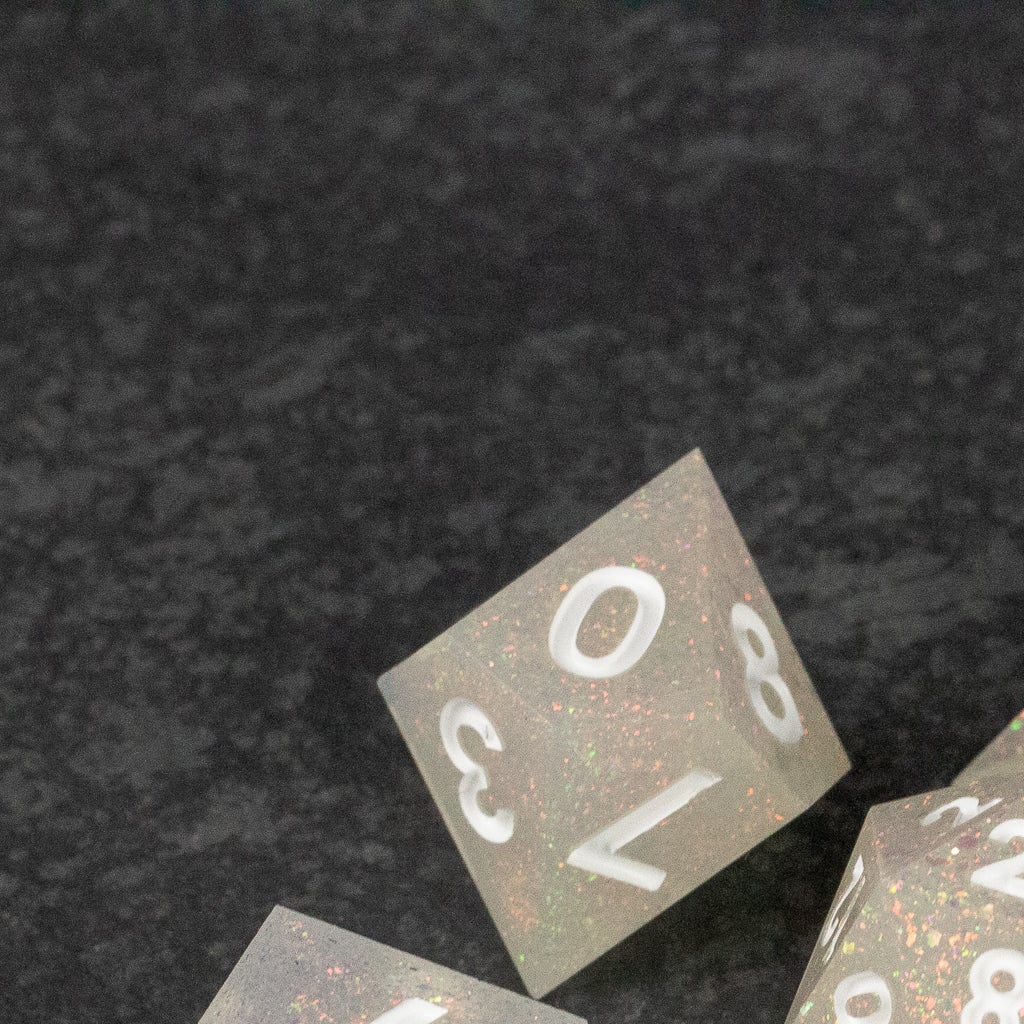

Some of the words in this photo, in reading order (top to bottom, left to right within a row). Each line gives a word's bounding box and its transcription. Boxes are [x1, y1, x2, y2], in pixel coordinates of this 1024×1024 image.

[548, 566, 666, 679] 0
[731, 602, 805, 744] 8
[439, 698, 515, 844] 3
[567, 770, 723, 892] 7
